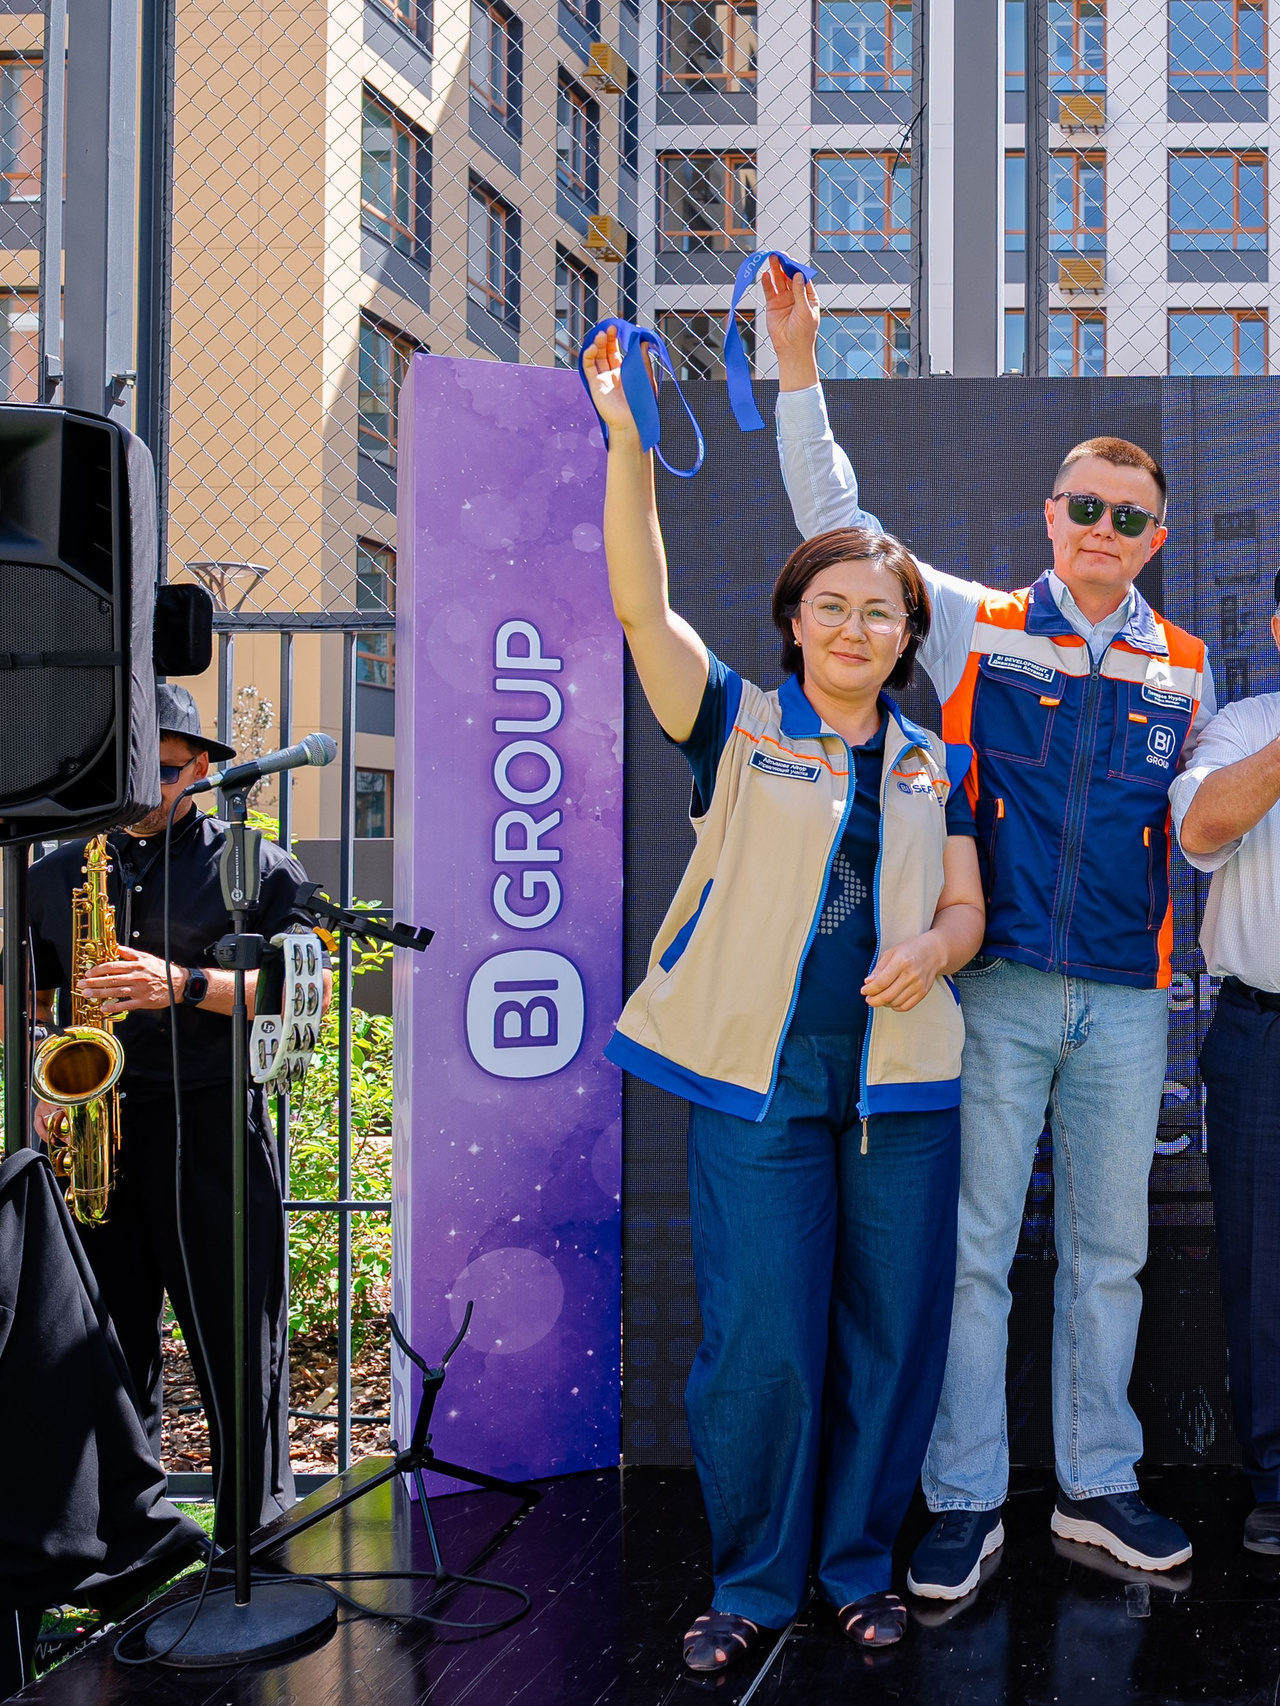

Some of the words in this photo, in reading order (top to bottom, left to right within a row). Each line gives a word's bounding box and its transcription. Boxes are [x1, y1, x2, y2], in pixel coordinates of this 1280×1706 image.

[1154, 730, 1171, 753] BI
[492, 619, 563, 930] GROUP
[263, 1022, 275, 1033] LP
[493, 978, 559, 1049] BI
